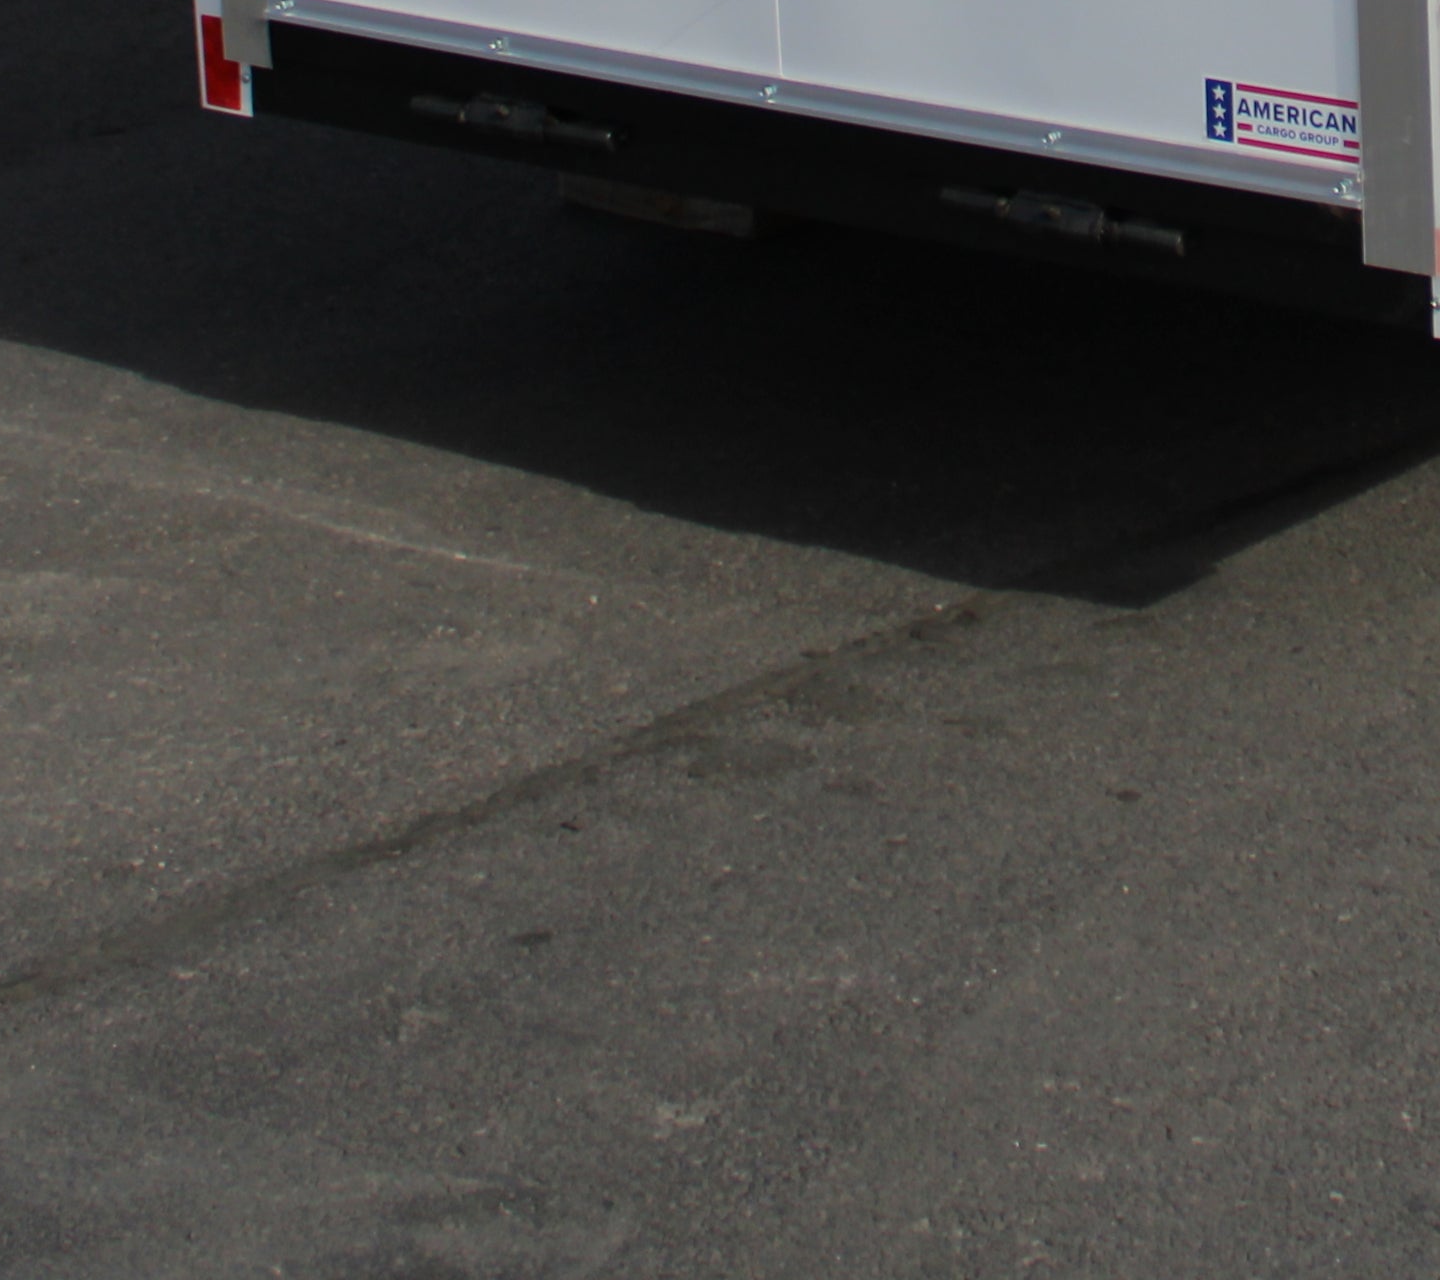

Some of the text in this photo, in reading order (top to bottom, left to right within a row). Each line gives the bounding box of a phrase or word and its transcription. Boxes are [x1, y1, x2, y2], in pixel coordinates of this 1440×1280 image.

[1237, 98, 1358, 135] AMERICAN
[1256, 124, 1340, 147] CARGO GROUP
